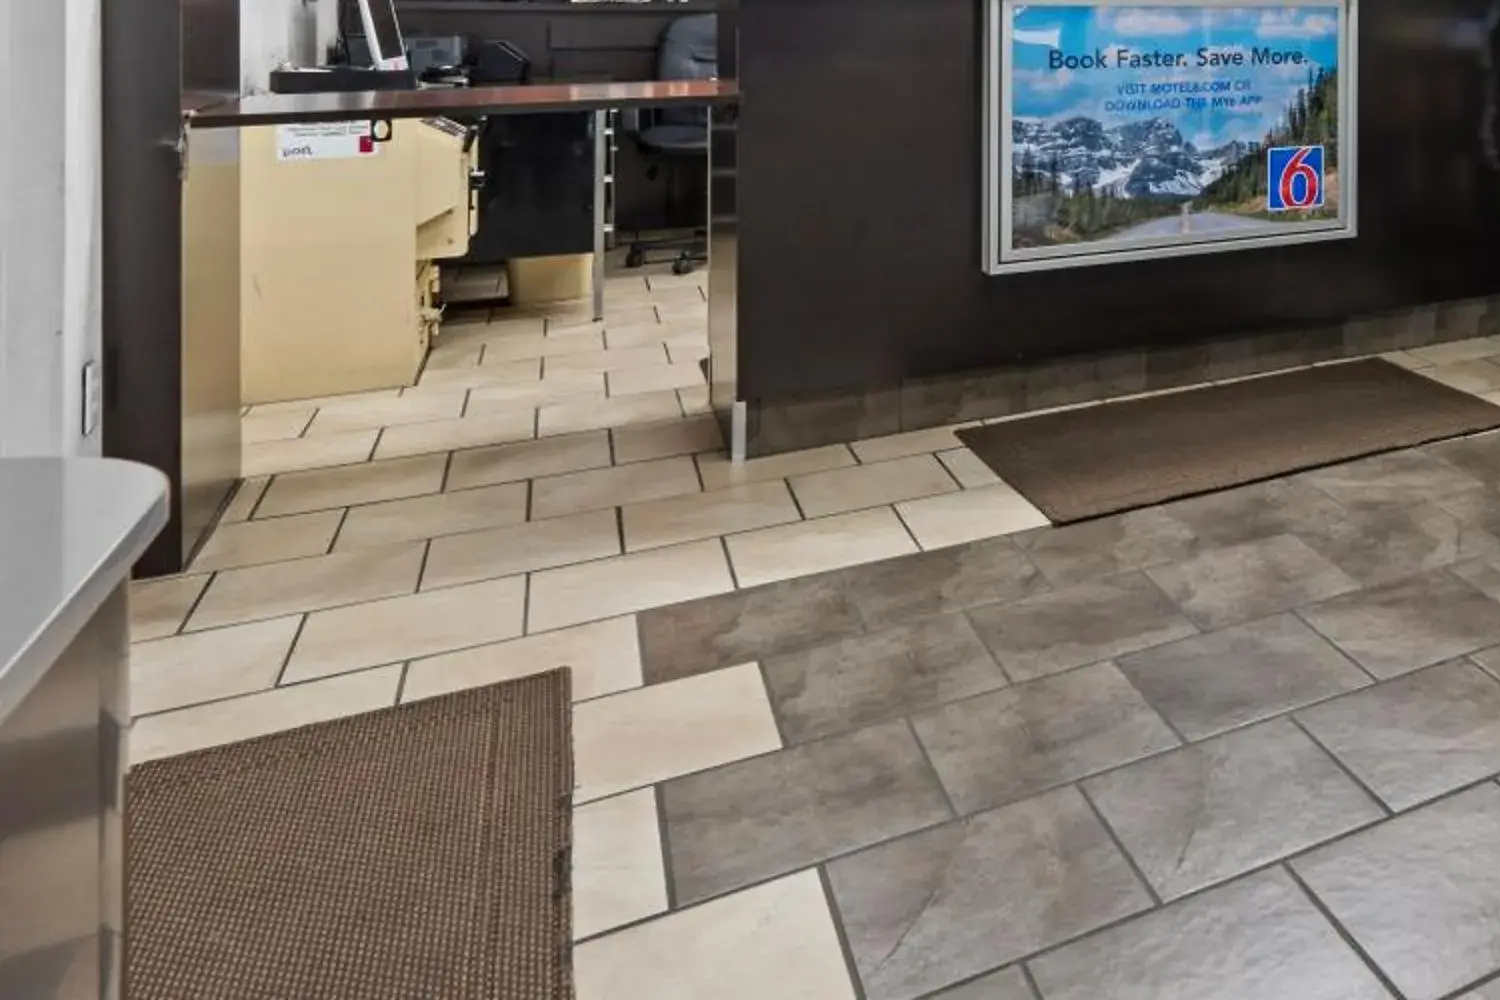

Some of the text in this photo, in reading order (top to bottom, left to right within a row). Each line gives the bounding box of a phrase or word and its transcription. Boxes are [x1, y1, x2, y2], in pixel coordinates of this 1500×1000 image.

[1048, 46, 1309, 70] Book Faster. Save More.
[1116, 82, 1147, 97] VISIT
[1104, 97, 1181, 113] DOWNLOAD
[1279, 146, 1320, 209] 6
